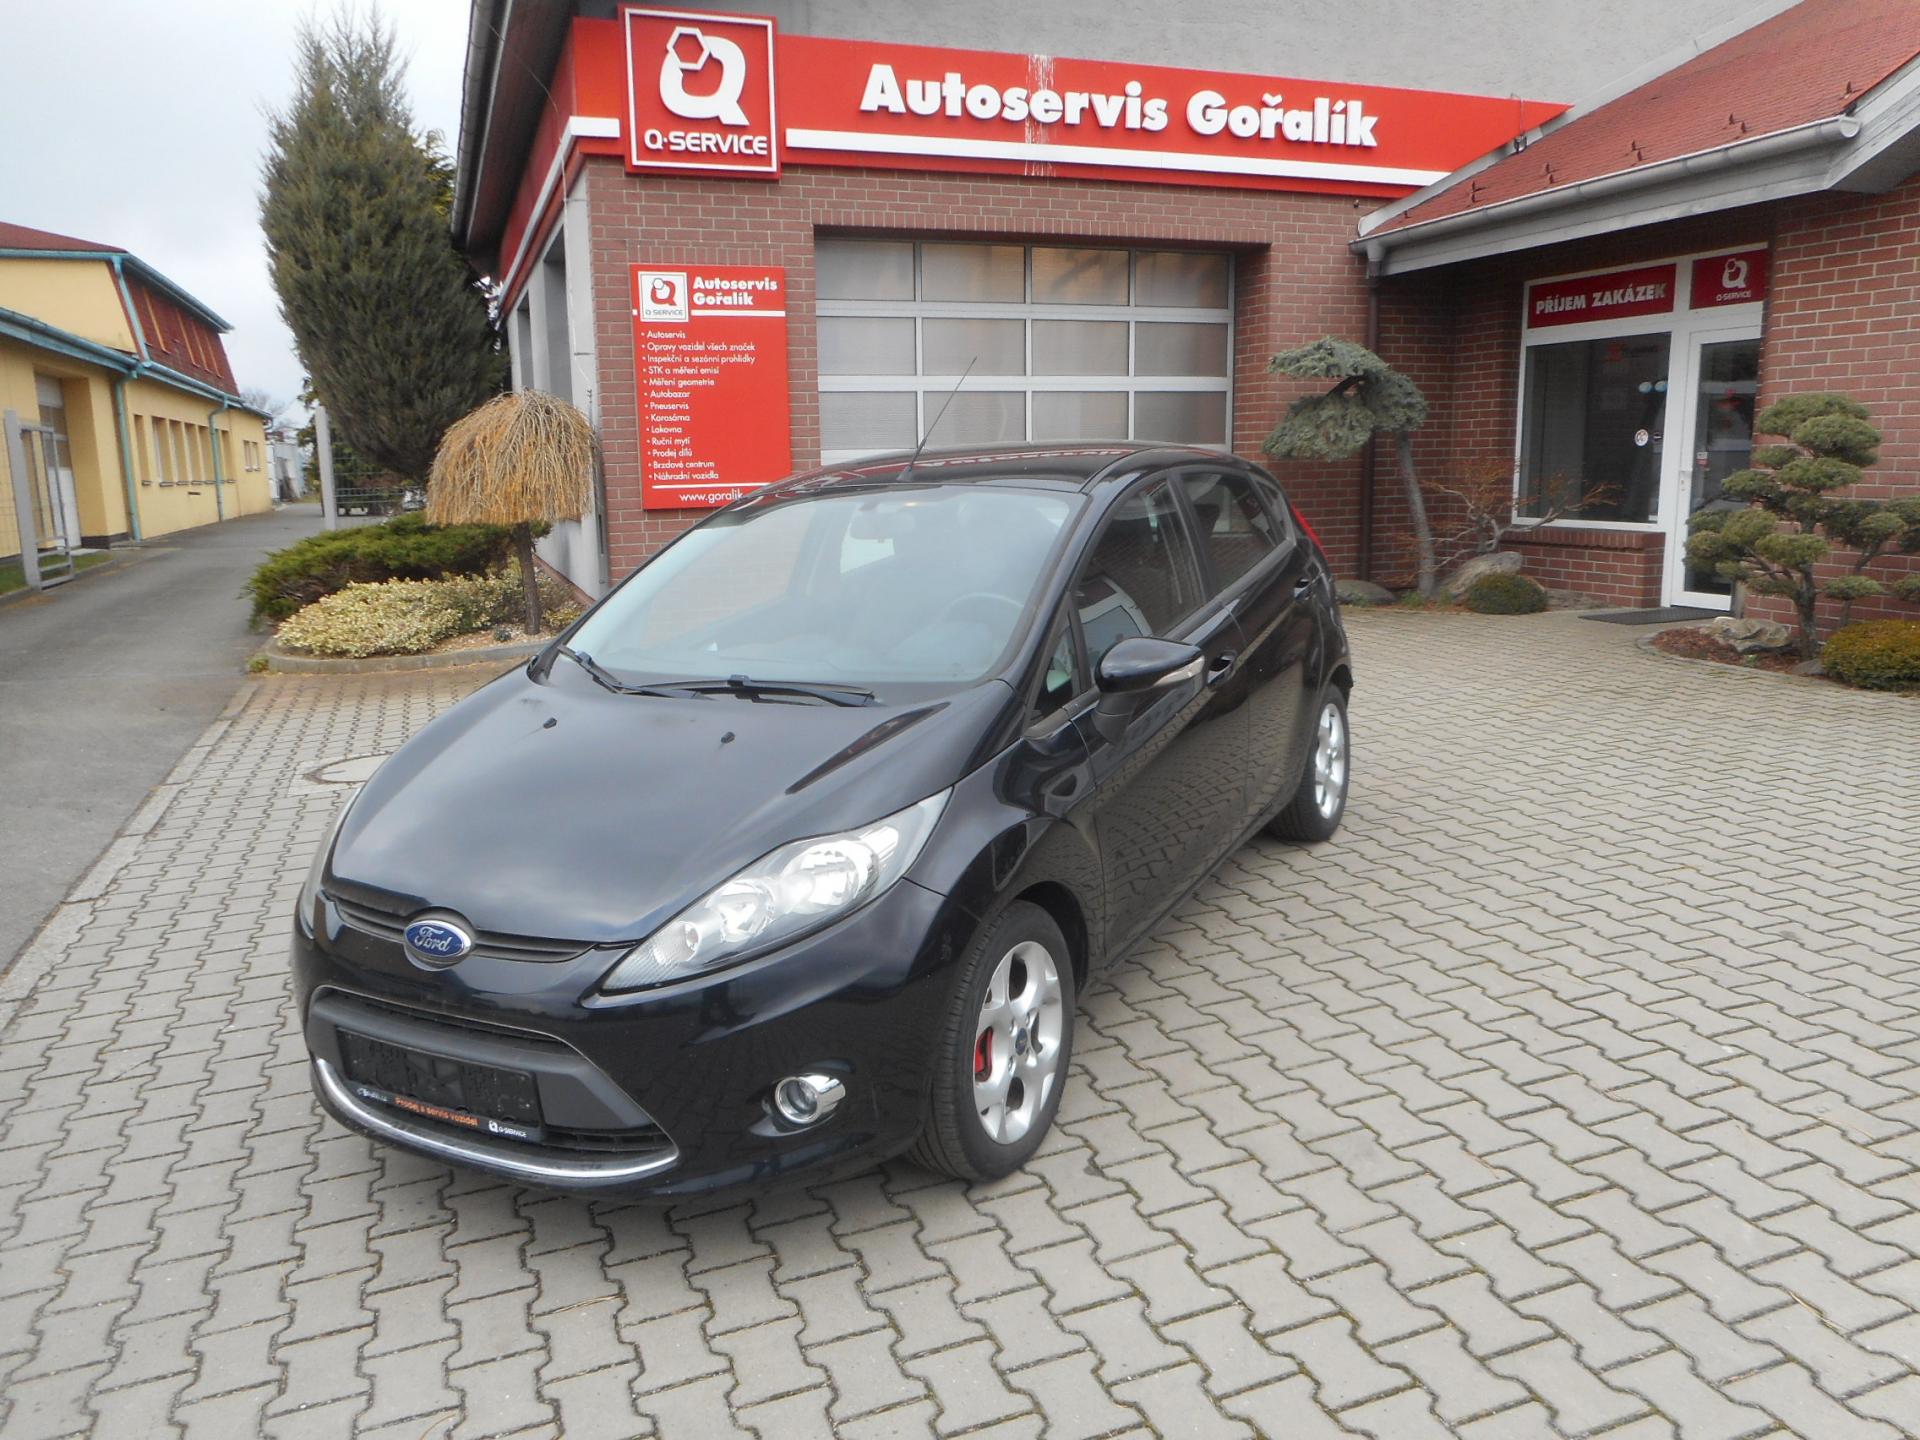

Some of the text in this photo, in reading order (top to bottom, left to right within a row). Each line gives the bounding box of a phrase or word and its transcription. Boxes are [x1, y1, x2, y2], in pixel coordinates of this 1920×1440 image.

[860, 63, 1378, 148] Autoservis Gořalík
[693, 276, 778, 291] Autoservis
[693, 292, 754, 306] Gořalík
[1536, 283, 1667, 315] PŘÍJEM ZAKÁZEK
[647, 330, 686, 339] Autoservis
[647, 341, 755, 352] Opravy vozidel všech značek
[648, 366, 663, 374] STK
[650, 389, 690, 398] Autobazar
[650, 401, 689, 410] Pneuservis
[651, 424, 682, 433] Lakovna
[652, 437, 672, 445] Ruční
[652, 448, 677, 458] Prodej
[653, 460, 715, 469] Brzdové centrum
[653, 470, 719, 481] Náhradní vozidla
[414, 926, 453, 952] Ford
